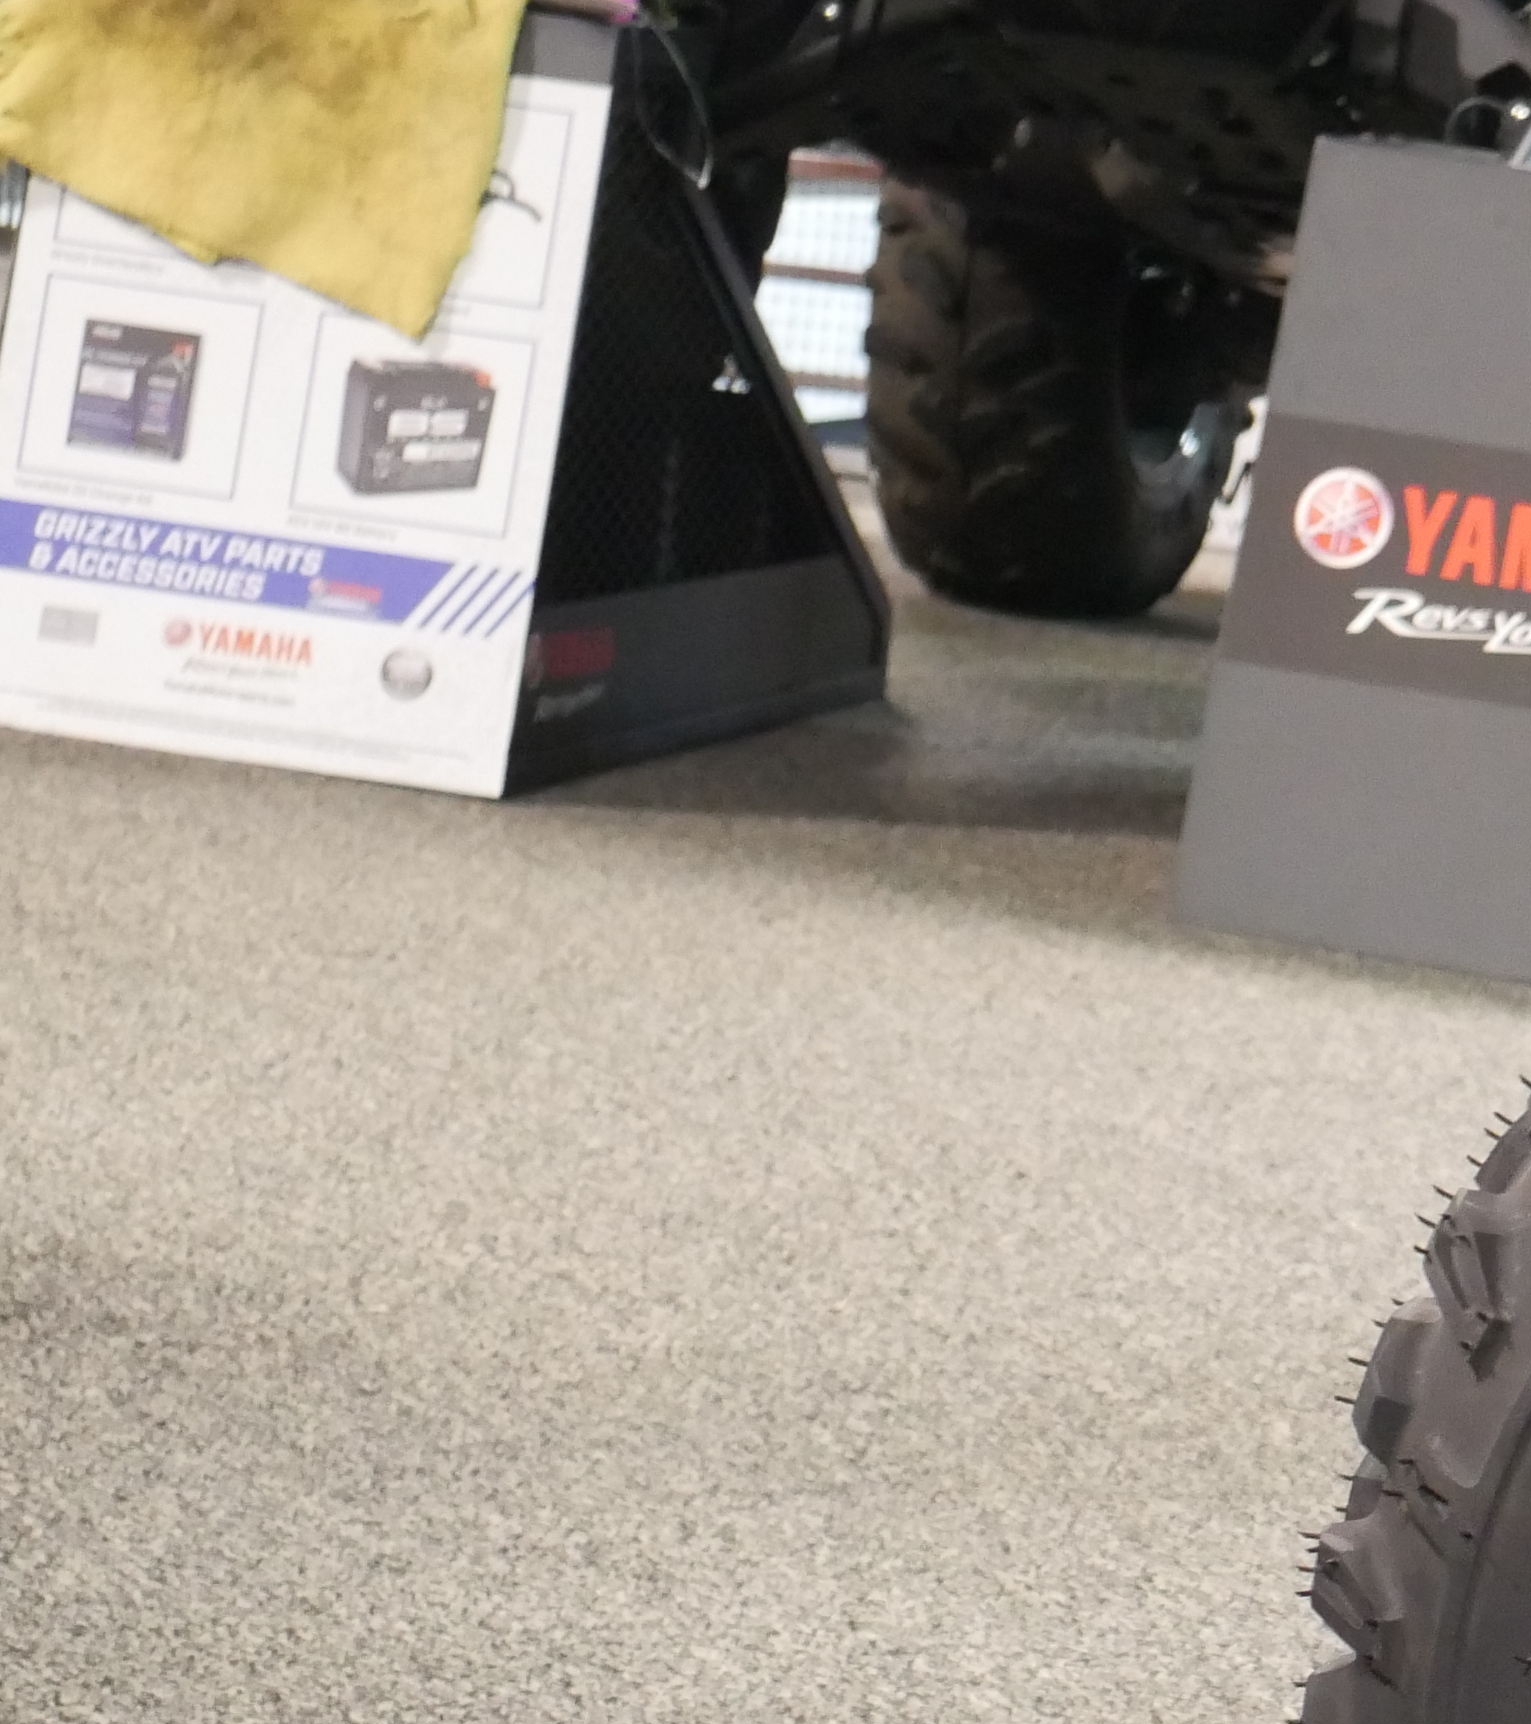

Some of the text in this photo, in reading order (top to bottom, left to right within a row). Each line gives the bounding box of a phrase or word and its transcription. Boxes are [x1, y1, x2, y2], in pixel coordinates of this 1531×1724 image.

[33, 507, 326, 579] GRIZZLY ATV PARTS
[54, 543, 268, 602] ACCESSORIES
[198, 622, 315, 668] YAMAHA
